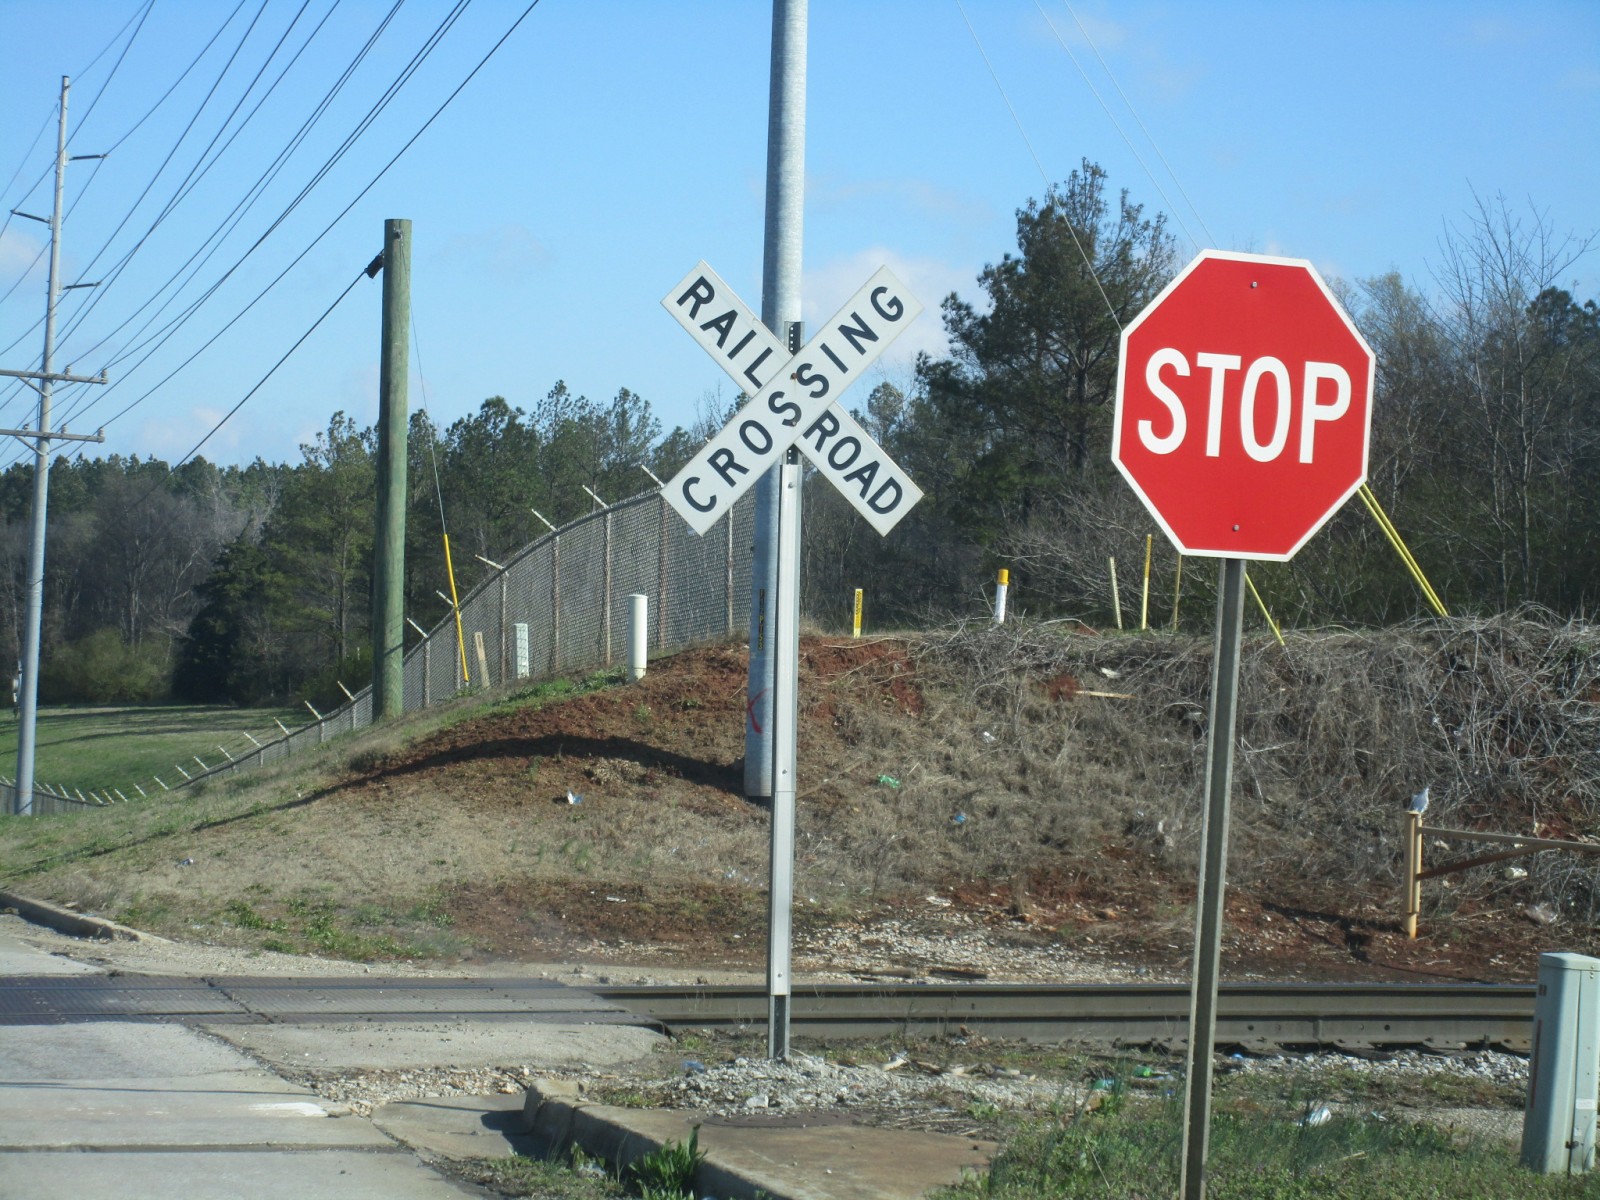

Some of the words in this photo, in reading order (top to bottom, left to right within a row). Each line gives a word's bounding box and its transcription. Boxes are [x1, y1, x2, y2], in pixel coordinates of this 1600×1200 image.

[676, 275, 774, 389] RAIL
[802, 409, 903, 515] ROAD
[682, 286, 904, 513] CROSSING
[1138, 347, 1352, 464] STOP
